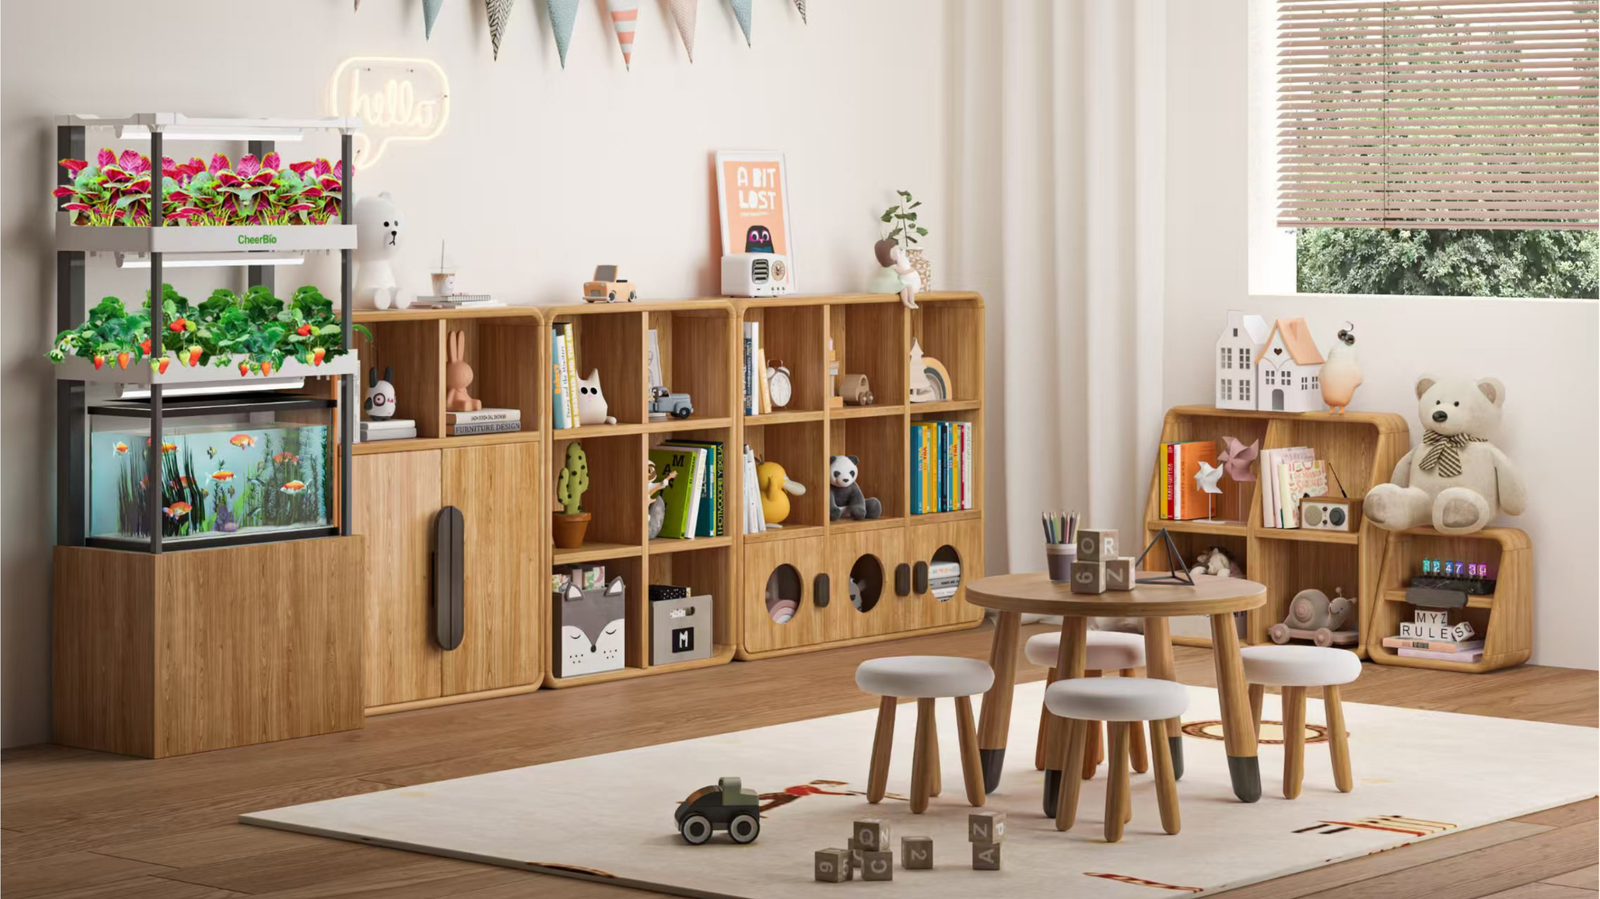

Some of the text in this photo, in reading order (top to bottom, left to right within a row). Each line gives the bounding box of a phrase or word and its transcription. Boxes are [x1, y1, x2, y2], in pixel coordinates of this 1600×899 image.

[350, 68, 436, 128] hello
[737, 166, 776, 188] A BIT
[738, 190, 776, 210] LOST
[237, 234, 278, 245] CheerBio
[455, 422, 520, 434] FURNITURE DESIGN
[1103, 537, 1114, 555] R
[678, 630, 689, 648] M
[859, 828, 875, 847] Q
[978, 848, 995, 865] A
